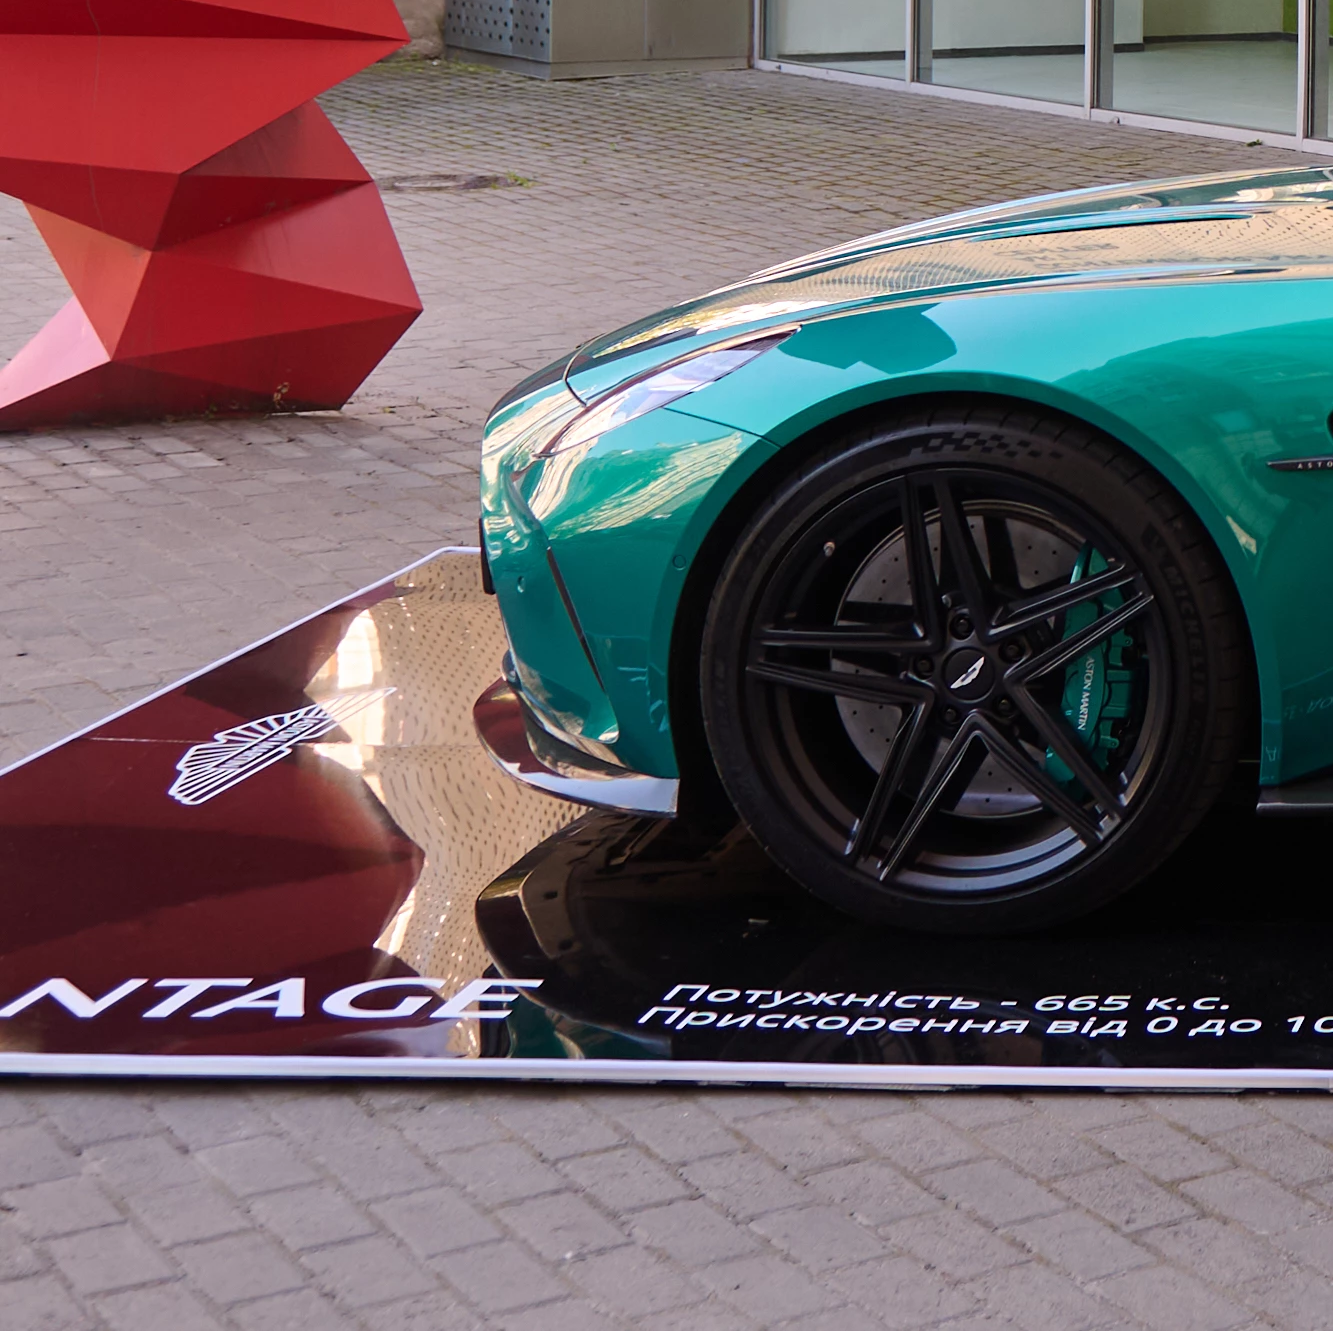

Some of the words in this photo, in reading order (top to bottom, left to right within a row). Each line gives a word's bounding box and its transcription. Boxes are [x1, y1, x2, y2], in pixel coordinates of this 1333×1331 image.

[1164, 565, 1206, 704] MICHELIN
[1083, 655, 1096, 690] ASTON
[1077, 690, 1091, 731] MARTIN
[662, 984, 980, 1010] Потужність
[1034, 995, 1132, 1012] 665
[1145, 996, 1230, 1012] к.с.
[637, 1006, 1030, 1036] Прискорення
[1046, 1016, 1128, 1038] від
[1146, 1016, 1179, 1034] 0
[1188, 1019, 1262, 1037] до
